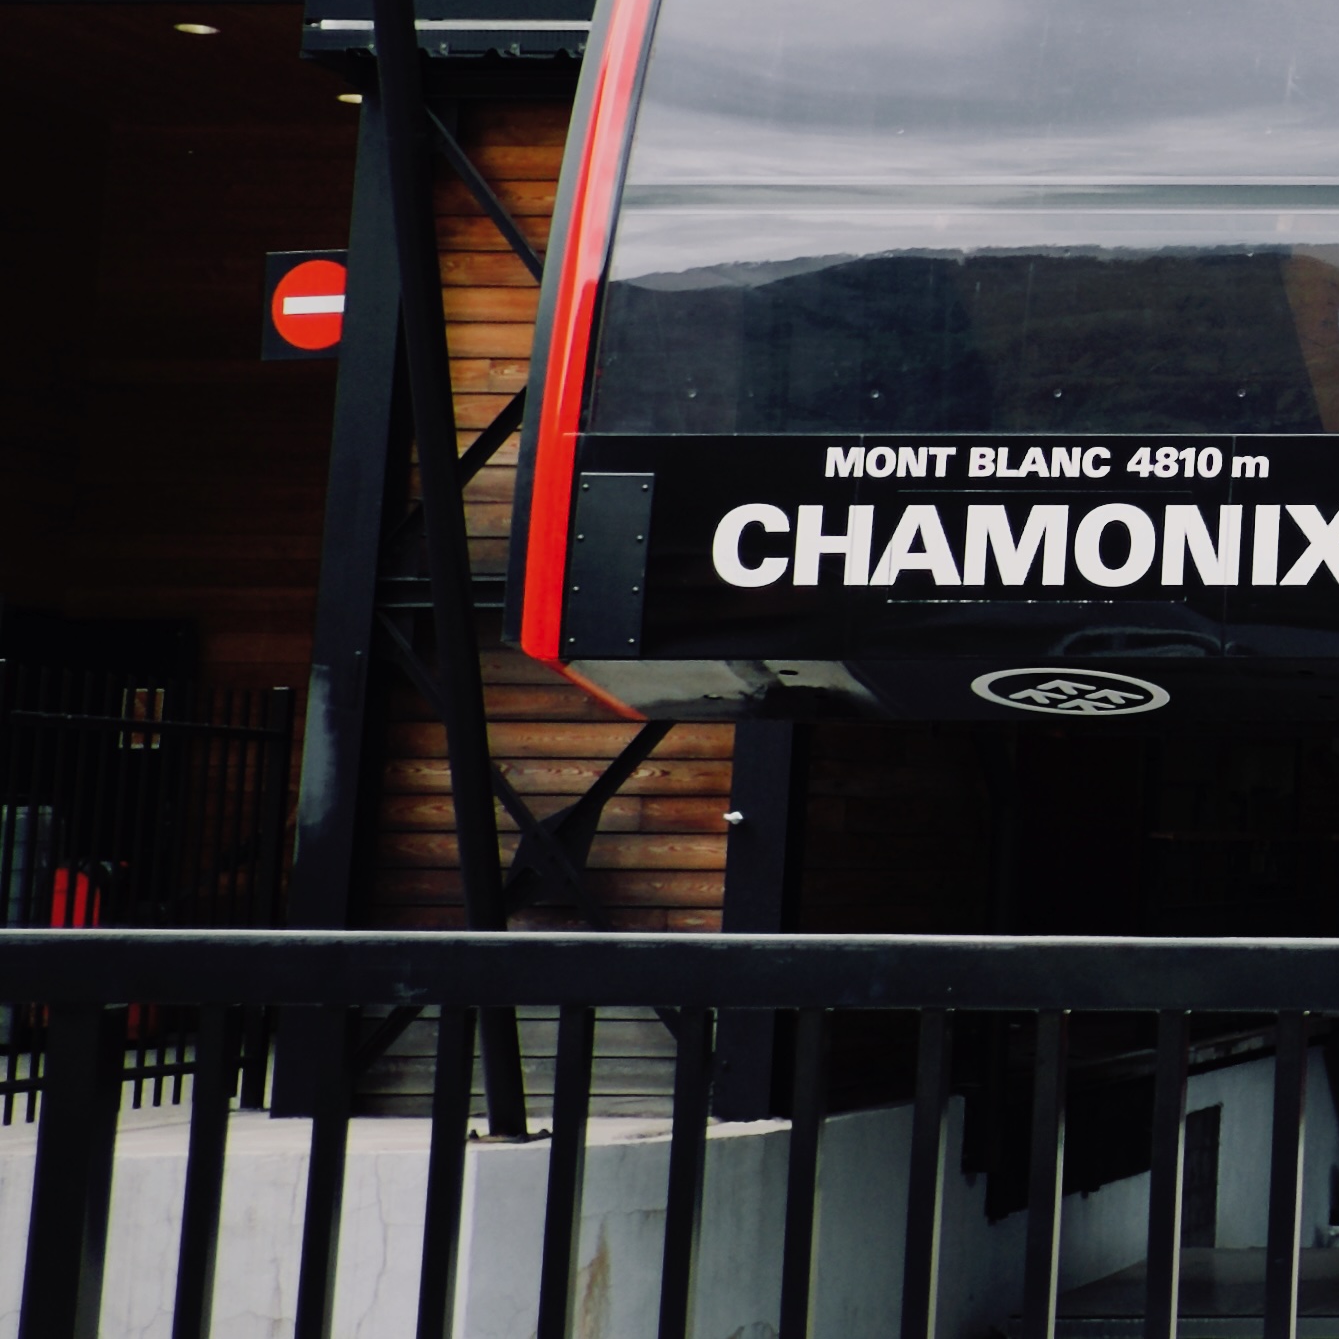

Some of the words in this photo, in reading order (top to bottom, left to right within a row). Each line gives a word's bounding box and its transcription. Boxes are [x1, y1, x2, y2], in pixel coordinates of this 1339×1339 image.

[824, 446, 957, 479] MONT
[967, 446, 1111, 479] BLANC
[1126, 446, 1223, 479] 4810
[1230, 455, 1270, 479] m
